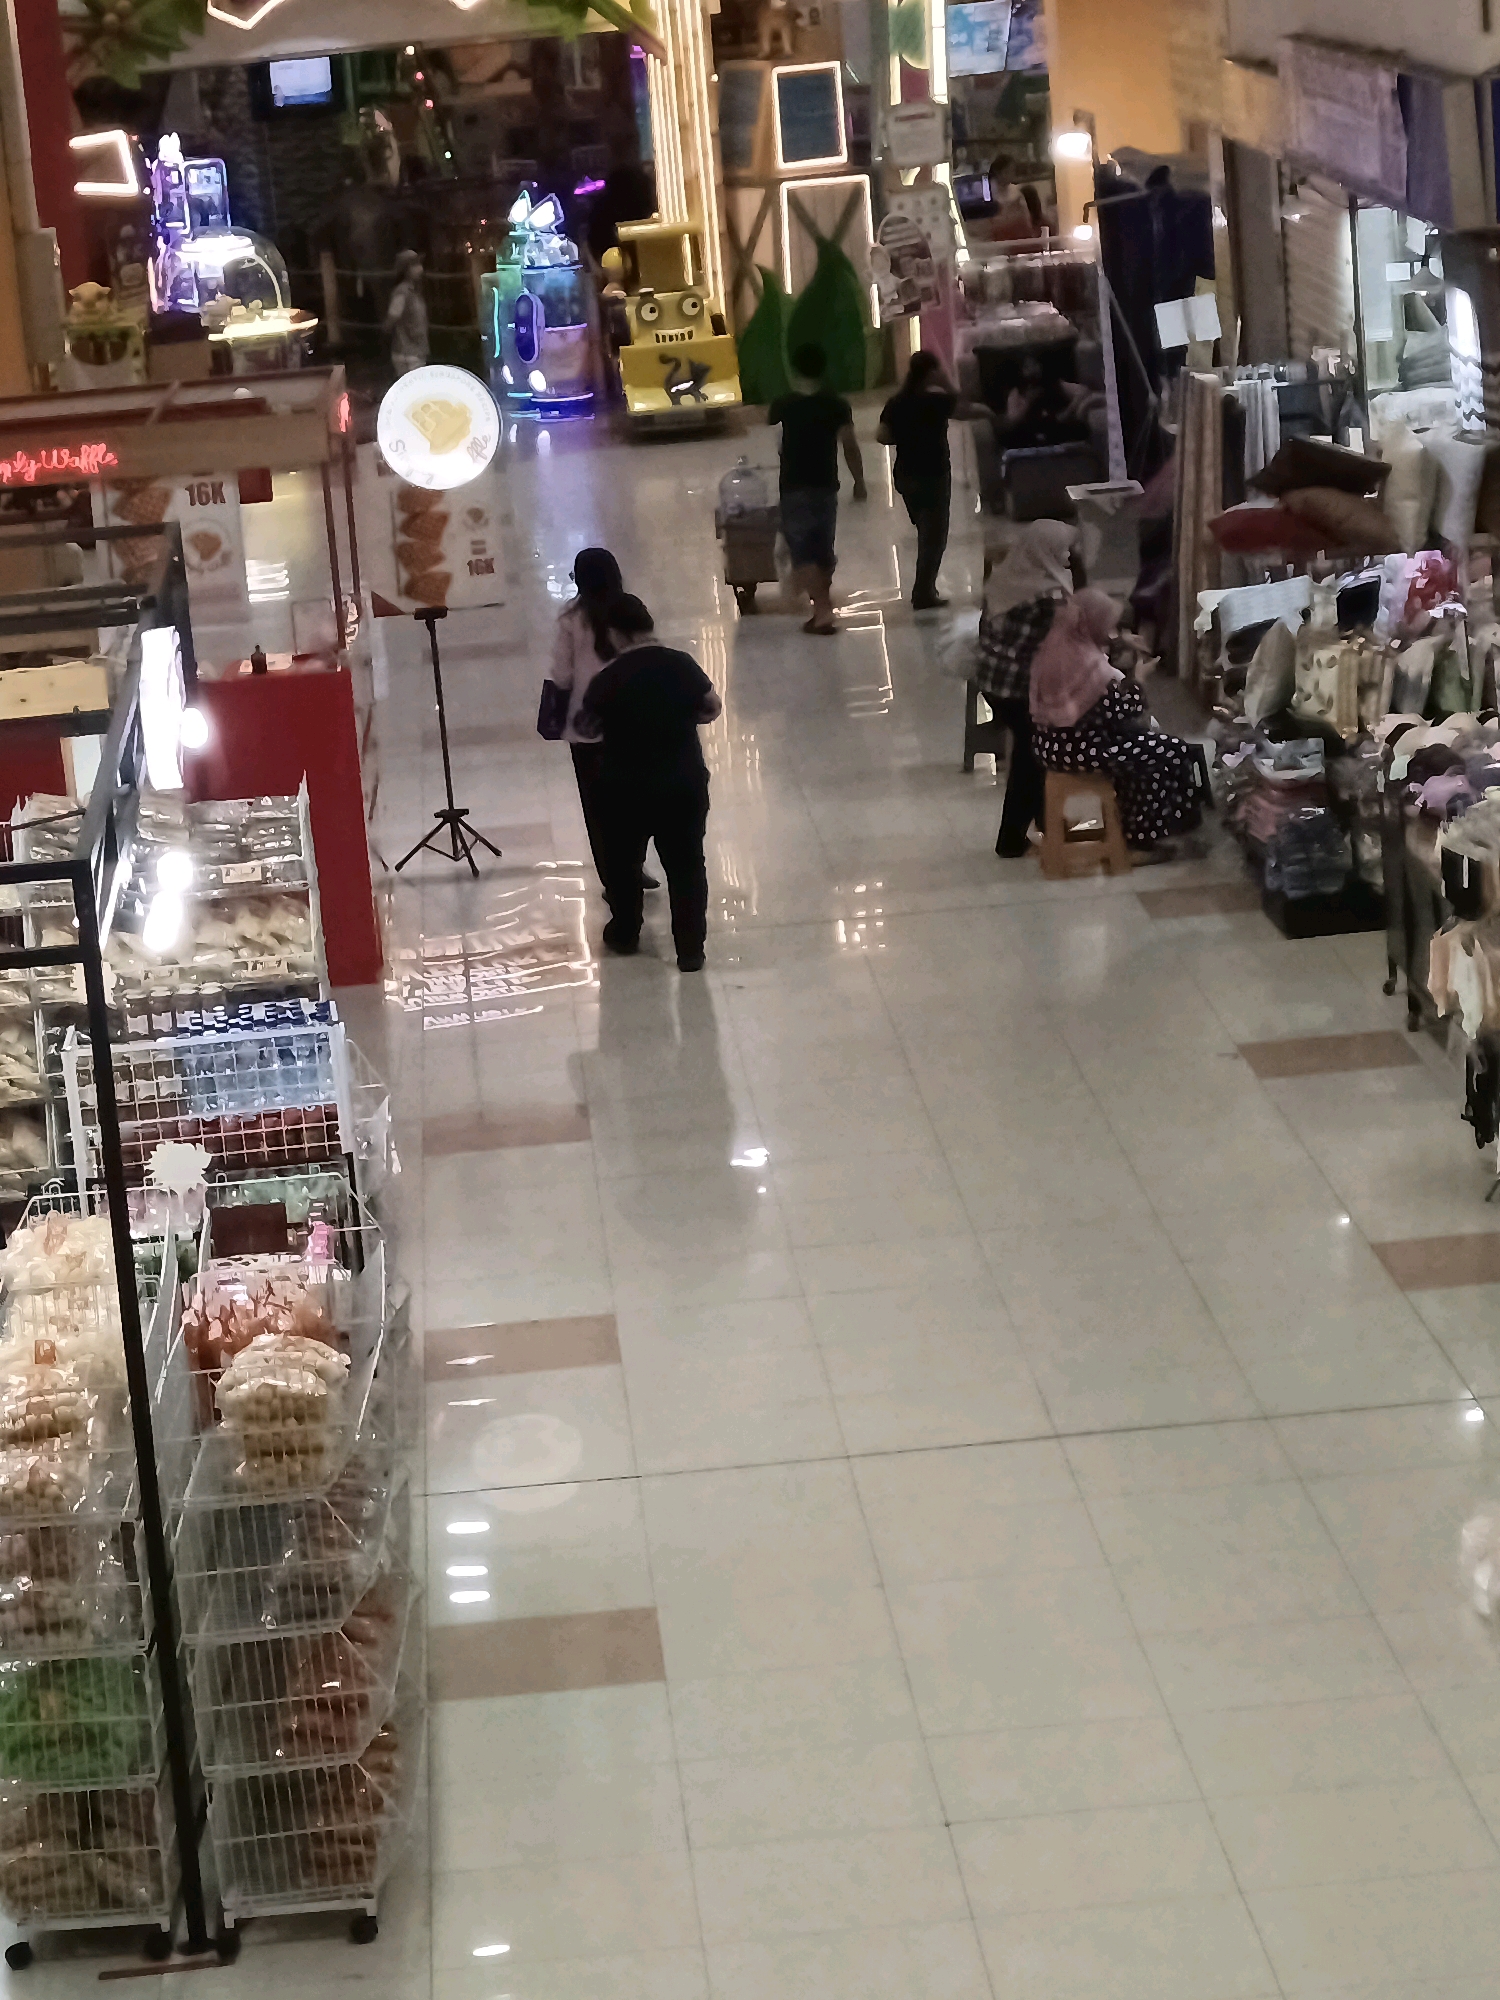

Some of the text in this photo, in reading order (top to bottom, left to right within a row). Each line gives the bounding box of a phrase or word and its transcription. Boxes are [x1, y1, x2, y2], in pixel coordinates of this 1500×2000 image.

[40, 442, 119, 474] Waffle
[185, 481, 227, 506] 16K
[466, 558, 495, 576] 16K
